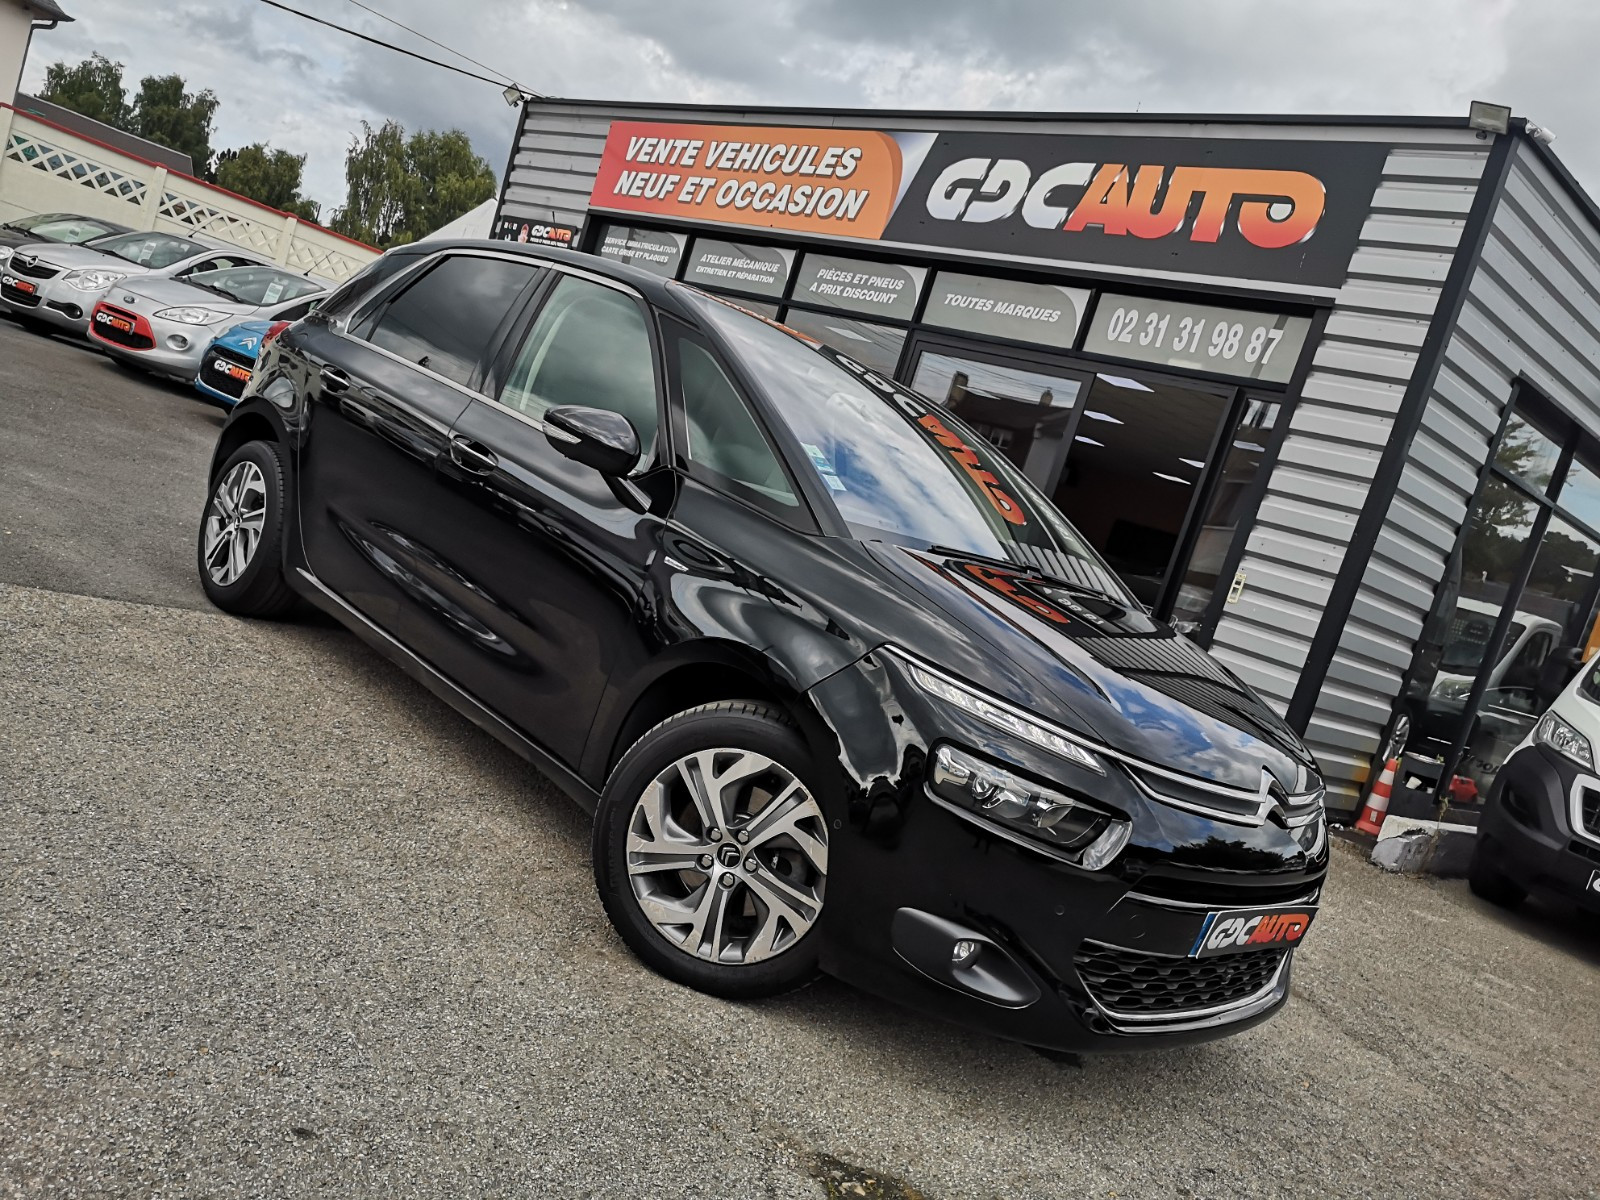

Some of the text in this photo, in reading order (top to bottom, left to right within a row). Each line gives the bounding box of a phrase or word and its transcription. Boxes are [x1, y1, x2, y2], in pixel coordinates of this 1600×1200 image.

[625, 136, 862, 178] VENTE VEHICULES
[613, 170, 869, 220] NEUF ET OCCASION
[601, 245, 670, 263] CARTE GRISE ET PLAQUES
[604, 236, 678, 254] SERVICE IMMATRICULATION
[700, 253, 780, 273] ATELIER MÉCANIQUE
[695, 265, 775, 284] ENTRETIEN ET RÉPARATION
[817, 267, 905, 290] PIÈCES ET PNEUS
[809, 282, 898, 304] A PRIX DISCOUNT
[944, 293, 1061, 322] TOUTES MARQUES
[1107, 307, 1284, 365] 02 31 31 98 87
